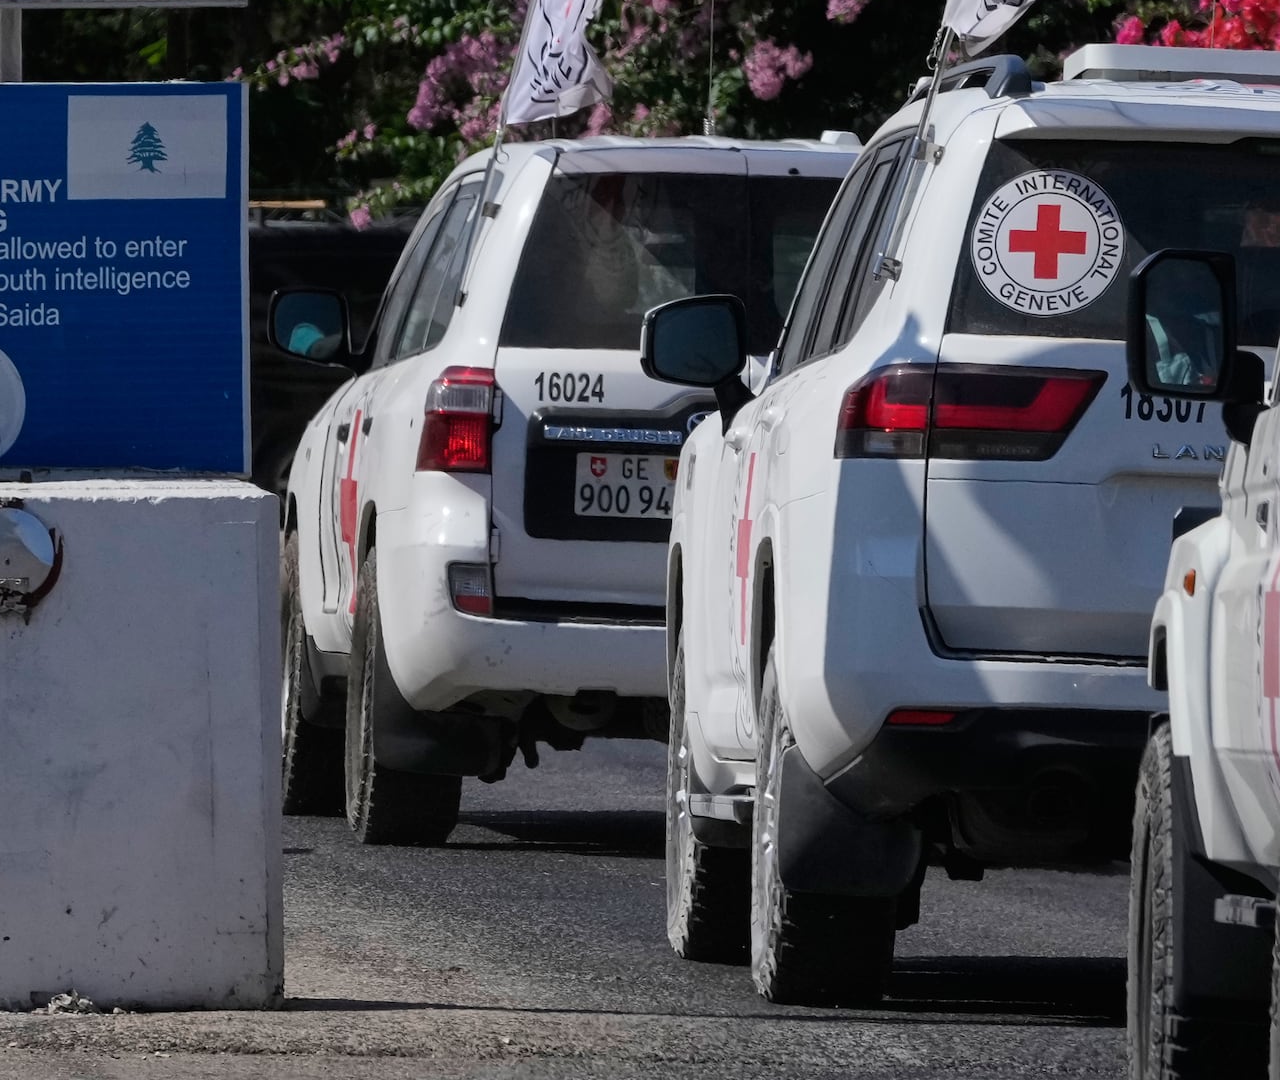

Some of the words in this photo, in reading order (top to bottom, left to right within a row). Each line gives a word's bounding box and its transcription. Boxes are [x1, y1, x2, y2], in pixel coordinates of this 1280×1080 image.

[975, 195, 1009, 276] COMITE
[1015, 173, 1120, 281] INTERNATIONAL
[95, 238, 117, 258] to
[124, 237, 187, 258] enter
[55, 267, 190, 295] intelligence
[1000, 282, 1089, 312] GENEVE
[534, 372, 605, 402] 16024
[1152, 443, 1225, 461] LAN
[622, 458, 649, 480] GE
[580, 484, 630, 513] 900
[639, 486, 670, 515] 94
